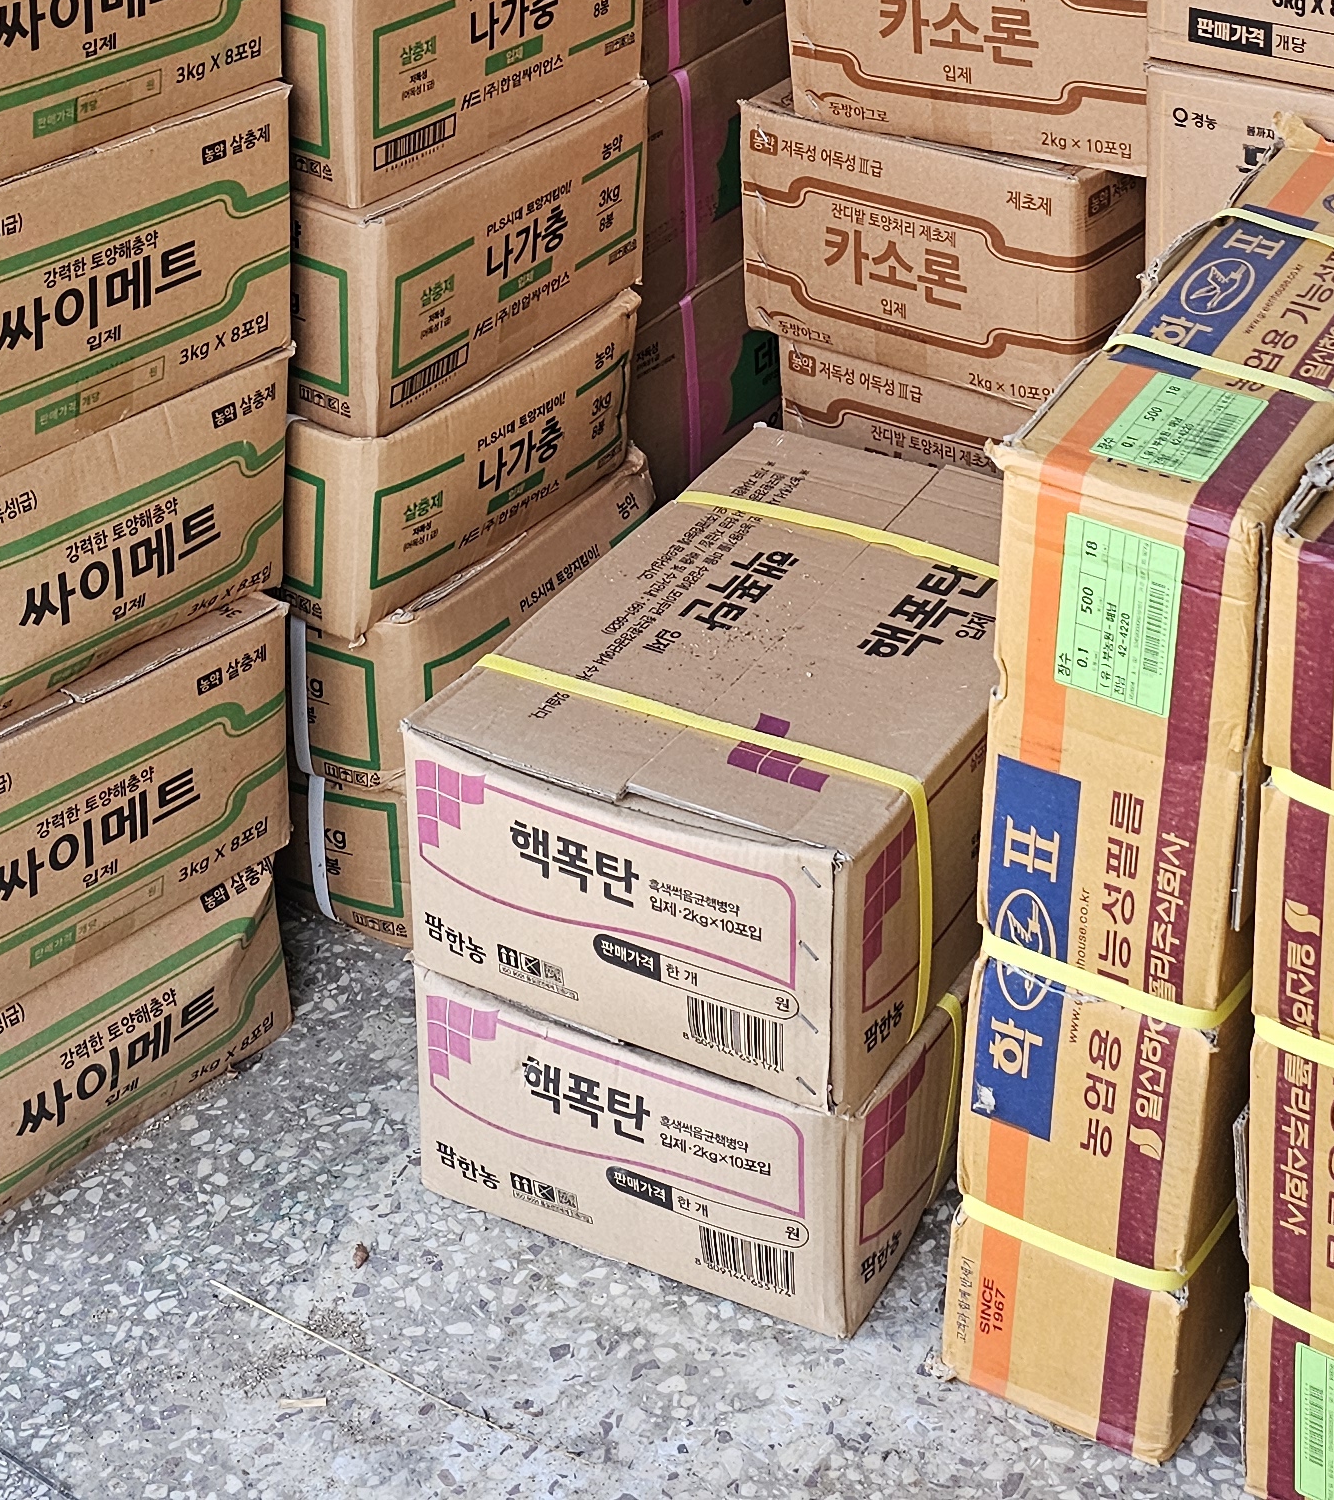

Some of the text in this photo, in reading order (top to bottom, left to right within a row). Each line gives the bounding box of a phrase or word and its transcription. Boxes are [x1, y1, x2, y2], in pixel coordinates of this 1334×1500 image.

[487, 205, 569, 281] 나가충
[824, 223, 969, 312] 카소론
[478, 415, 565, 493] 나가충
[19, 504, 222, 628] 싸이메트
[678, 551, 800, 632] 핵폭탄
[1080, 586, 1094, 614] 500
[857, 563, 997, 658] 핵폭탄
[509, 818, 640, 908] 핵폭탄
[424, 910, 487, 965] 팜한농
[600, 939, 654, 973] 판매가격
[15, 986, 220, 1138] 싸이메트
[523, 1056, 651, 1144] 핵폭탄
[436, 1140, 500, 1190] 팜한농
[978, 1276, 995, 1335] SINCE
[990, 1288, 1007, 1333] 1967
